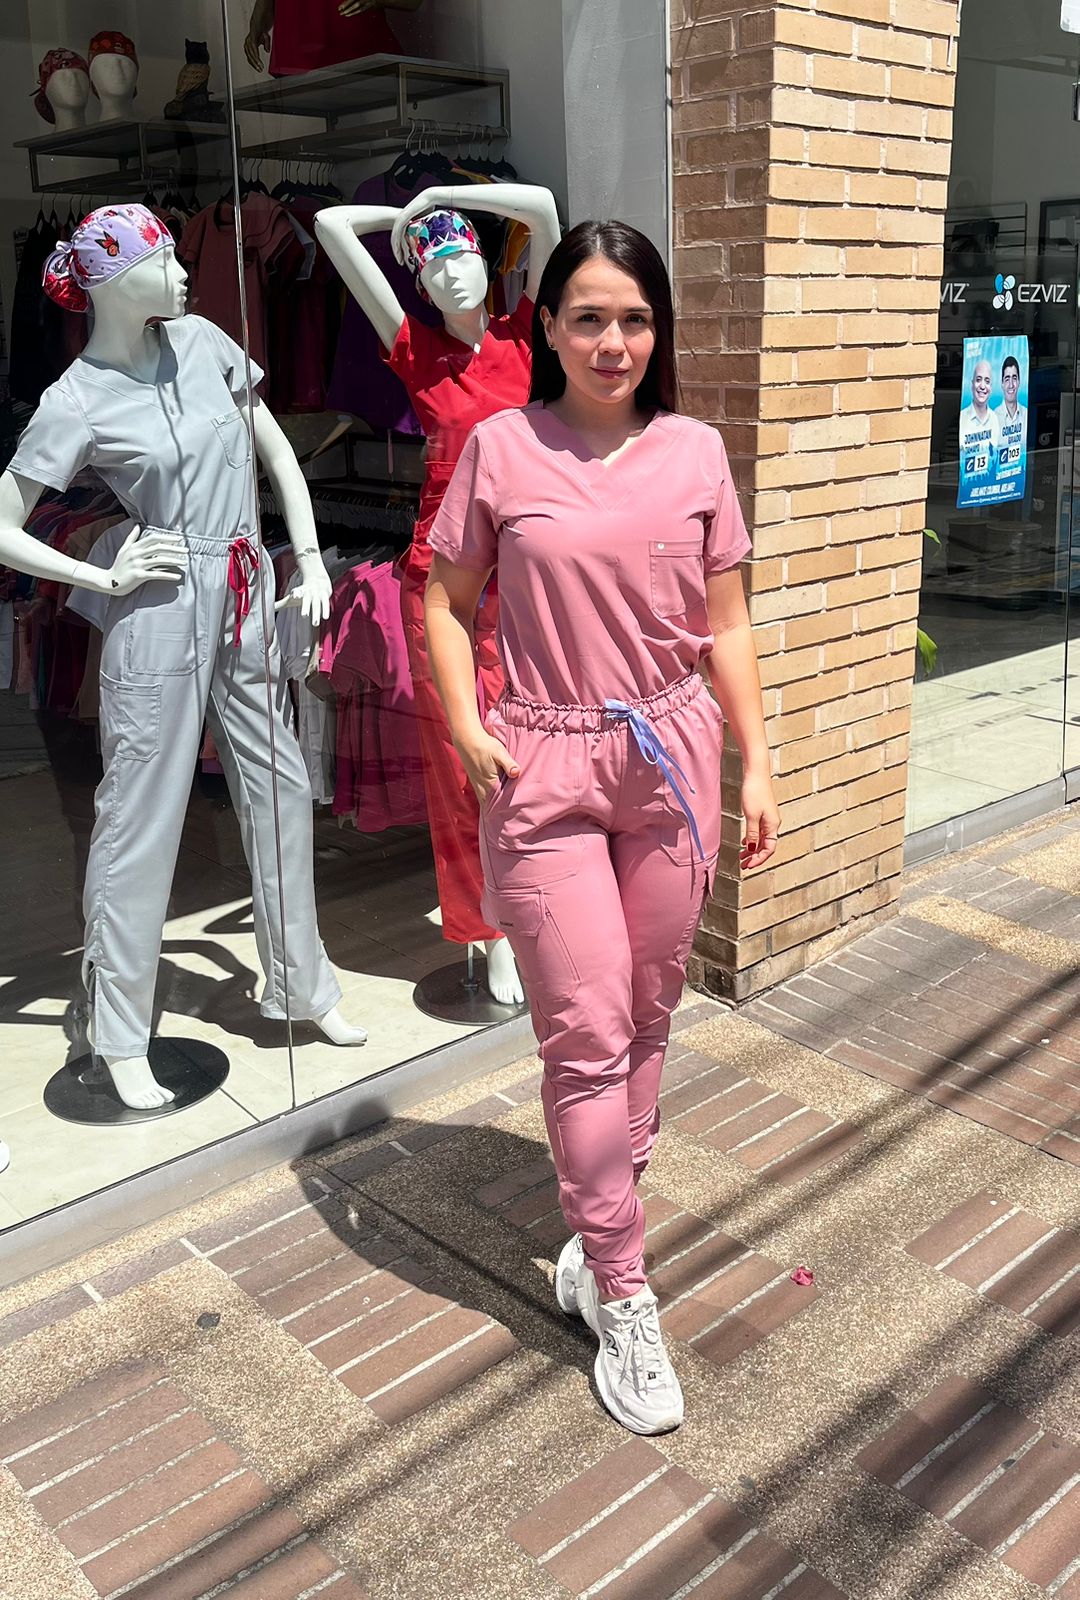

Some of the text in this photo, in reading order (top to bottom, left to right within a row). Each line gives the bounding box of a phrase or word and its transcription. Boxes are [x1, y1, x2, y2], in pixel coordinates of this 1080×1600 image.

[1017, 283, 1068, 303] EZVIZ
[1008, 447, 1020, 459] 103
[977, 456, 986, 469] 13
